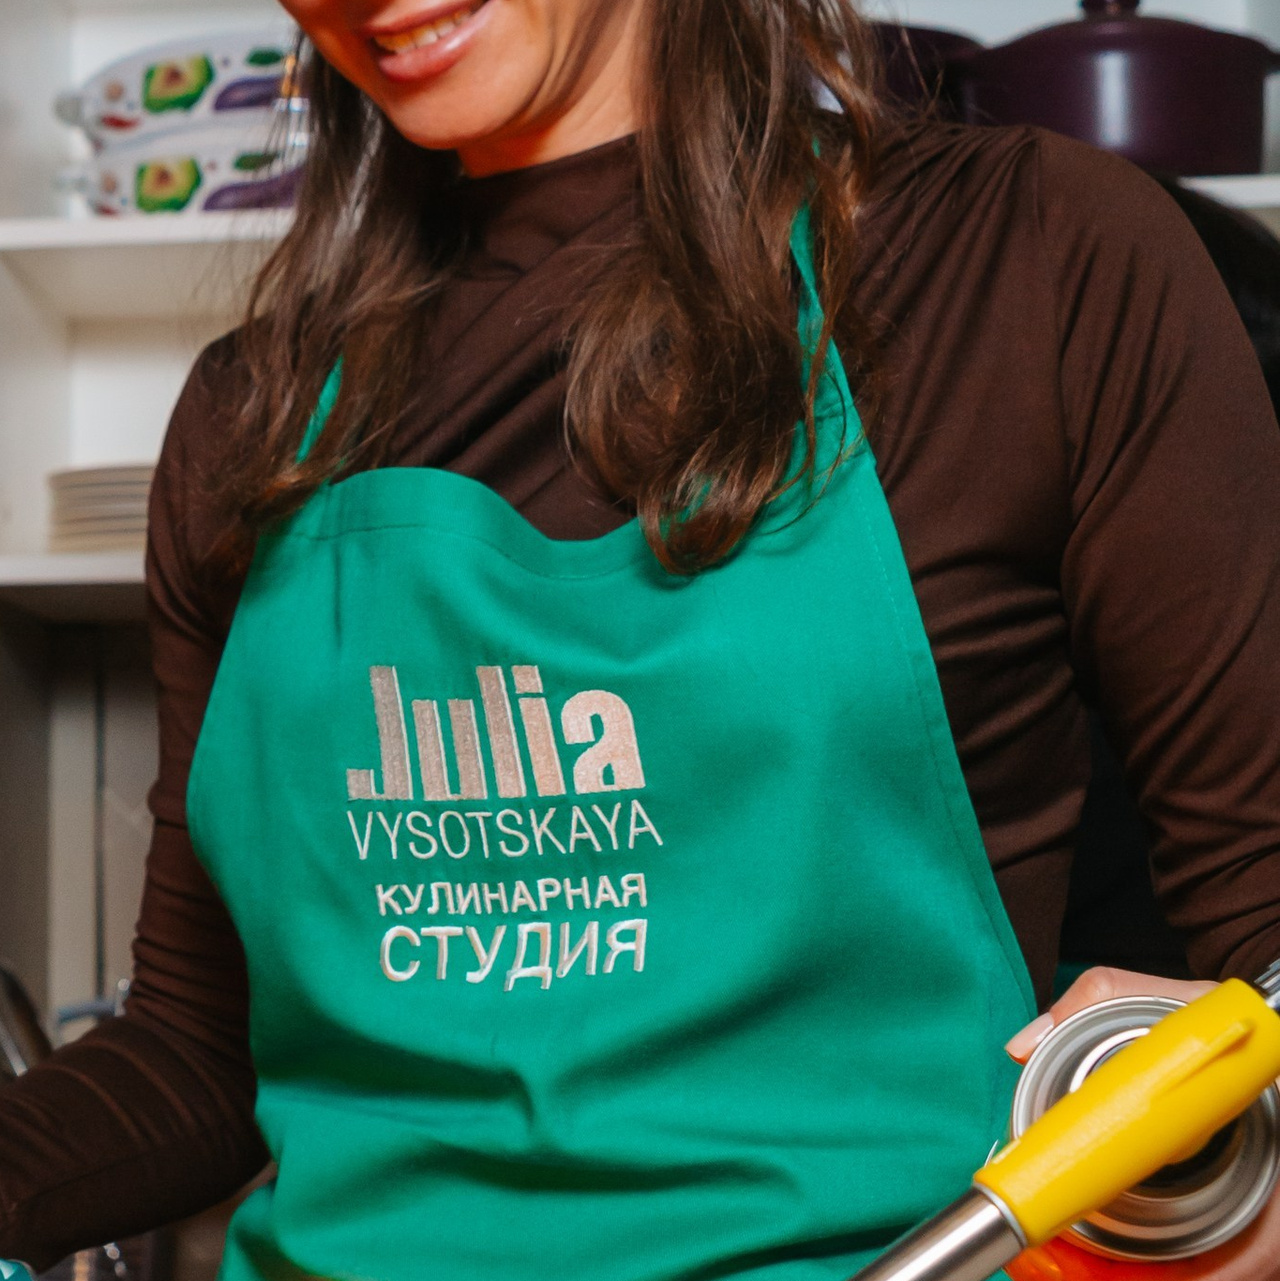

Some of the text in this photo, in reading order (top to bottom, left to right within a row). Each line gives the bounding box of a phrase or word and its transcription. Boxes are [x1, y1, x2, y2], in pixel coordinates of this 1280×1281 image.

[346, 665, 646, 801] Julia
[346, 799, 663, 860] VYSOTSKAYA
[375, 873, 648, 915] КУЛИНАРНАЯ
[380, 919, 648, 992] СТУДИЯ
